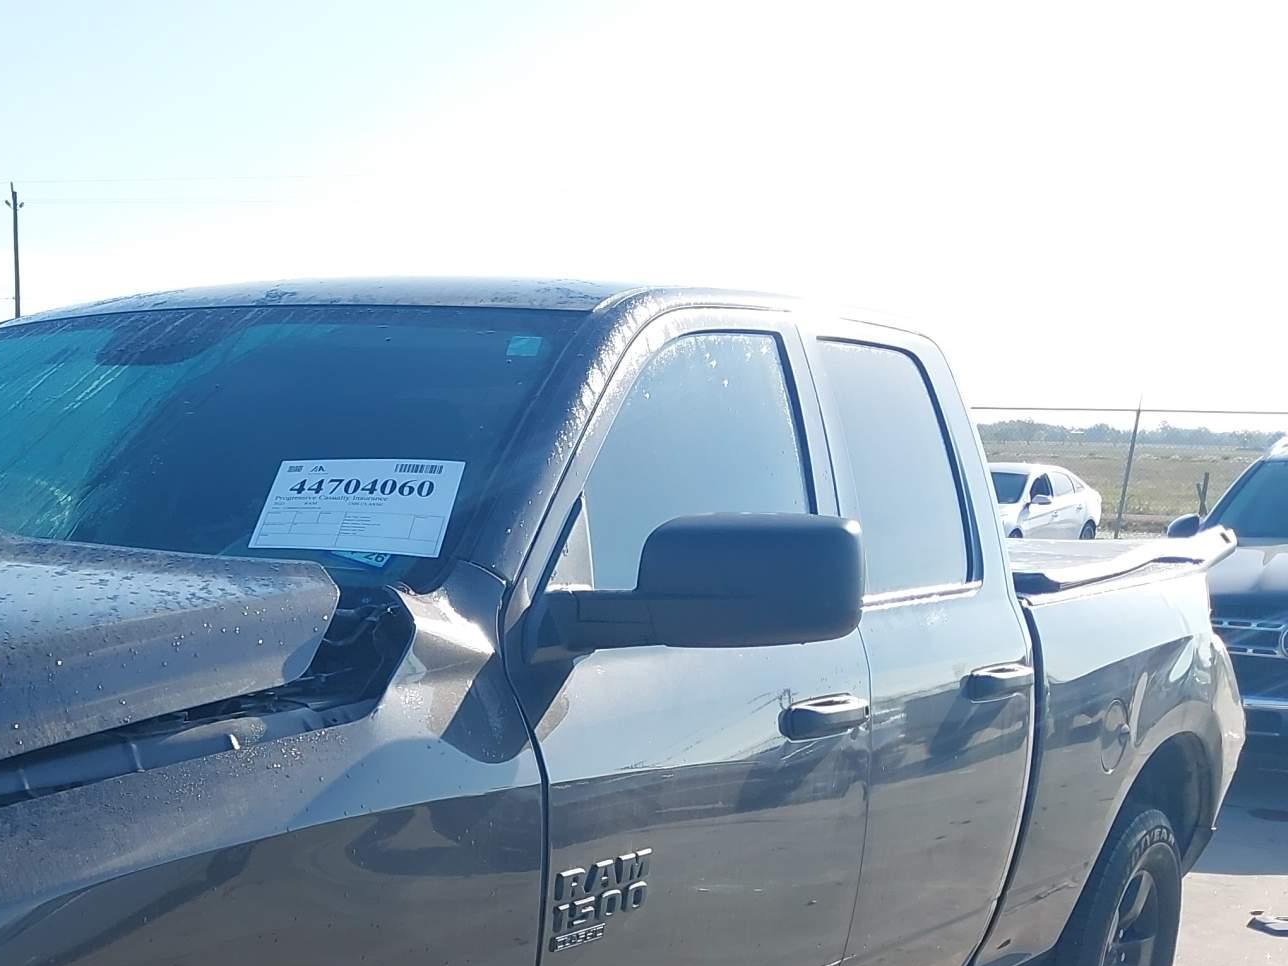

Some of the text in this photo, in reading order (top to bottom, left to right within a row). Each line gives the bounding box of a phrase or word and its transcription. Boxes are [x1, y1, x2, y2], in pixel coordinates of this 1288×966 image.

[289, 478, 434, 497] 44704060
[319, 495, 349, 503] Casualty
[352, 495, 388, 503] Insurance
[555, 848, 652, 900] RAM
[553, 881, 648, 932] 1500
